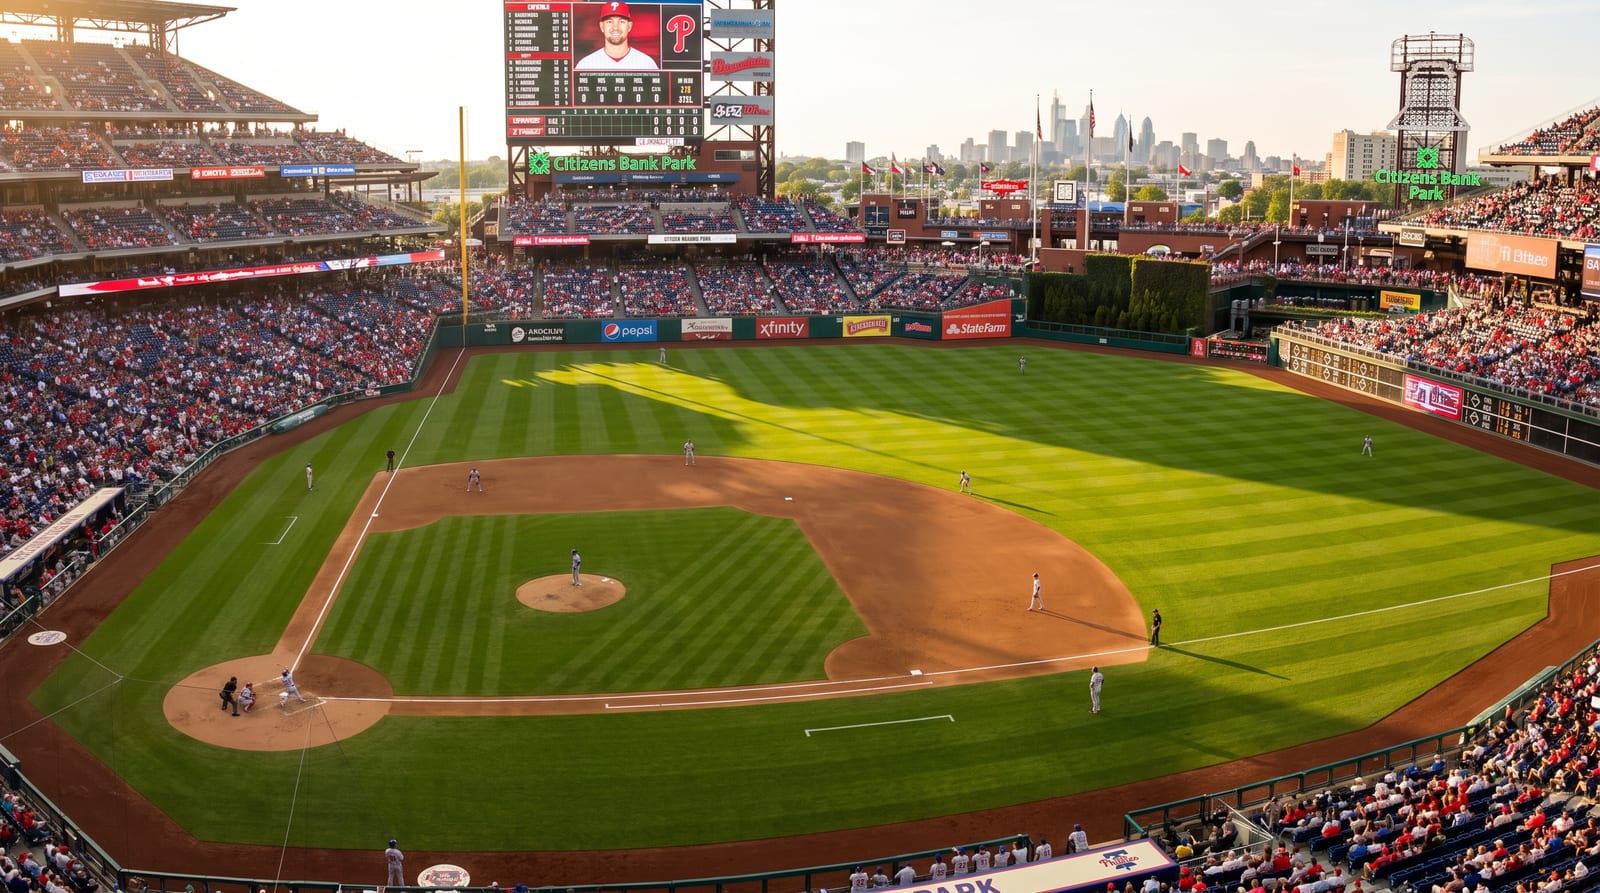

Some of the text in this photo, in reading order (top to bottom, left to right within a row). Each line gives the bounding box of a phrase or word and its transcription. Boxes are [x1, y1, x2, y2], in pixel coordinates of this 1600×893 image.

[666, 14, 695, 53] P
[553, 155, 697, 171] Citizens Bank Park
[1375, 168, 1480, 186] Citizens Bank
[1409, 186, 1444, 200] Park
[622, 325, 653, 336] pepsi
[760, 320, 804, 337] xfinity
